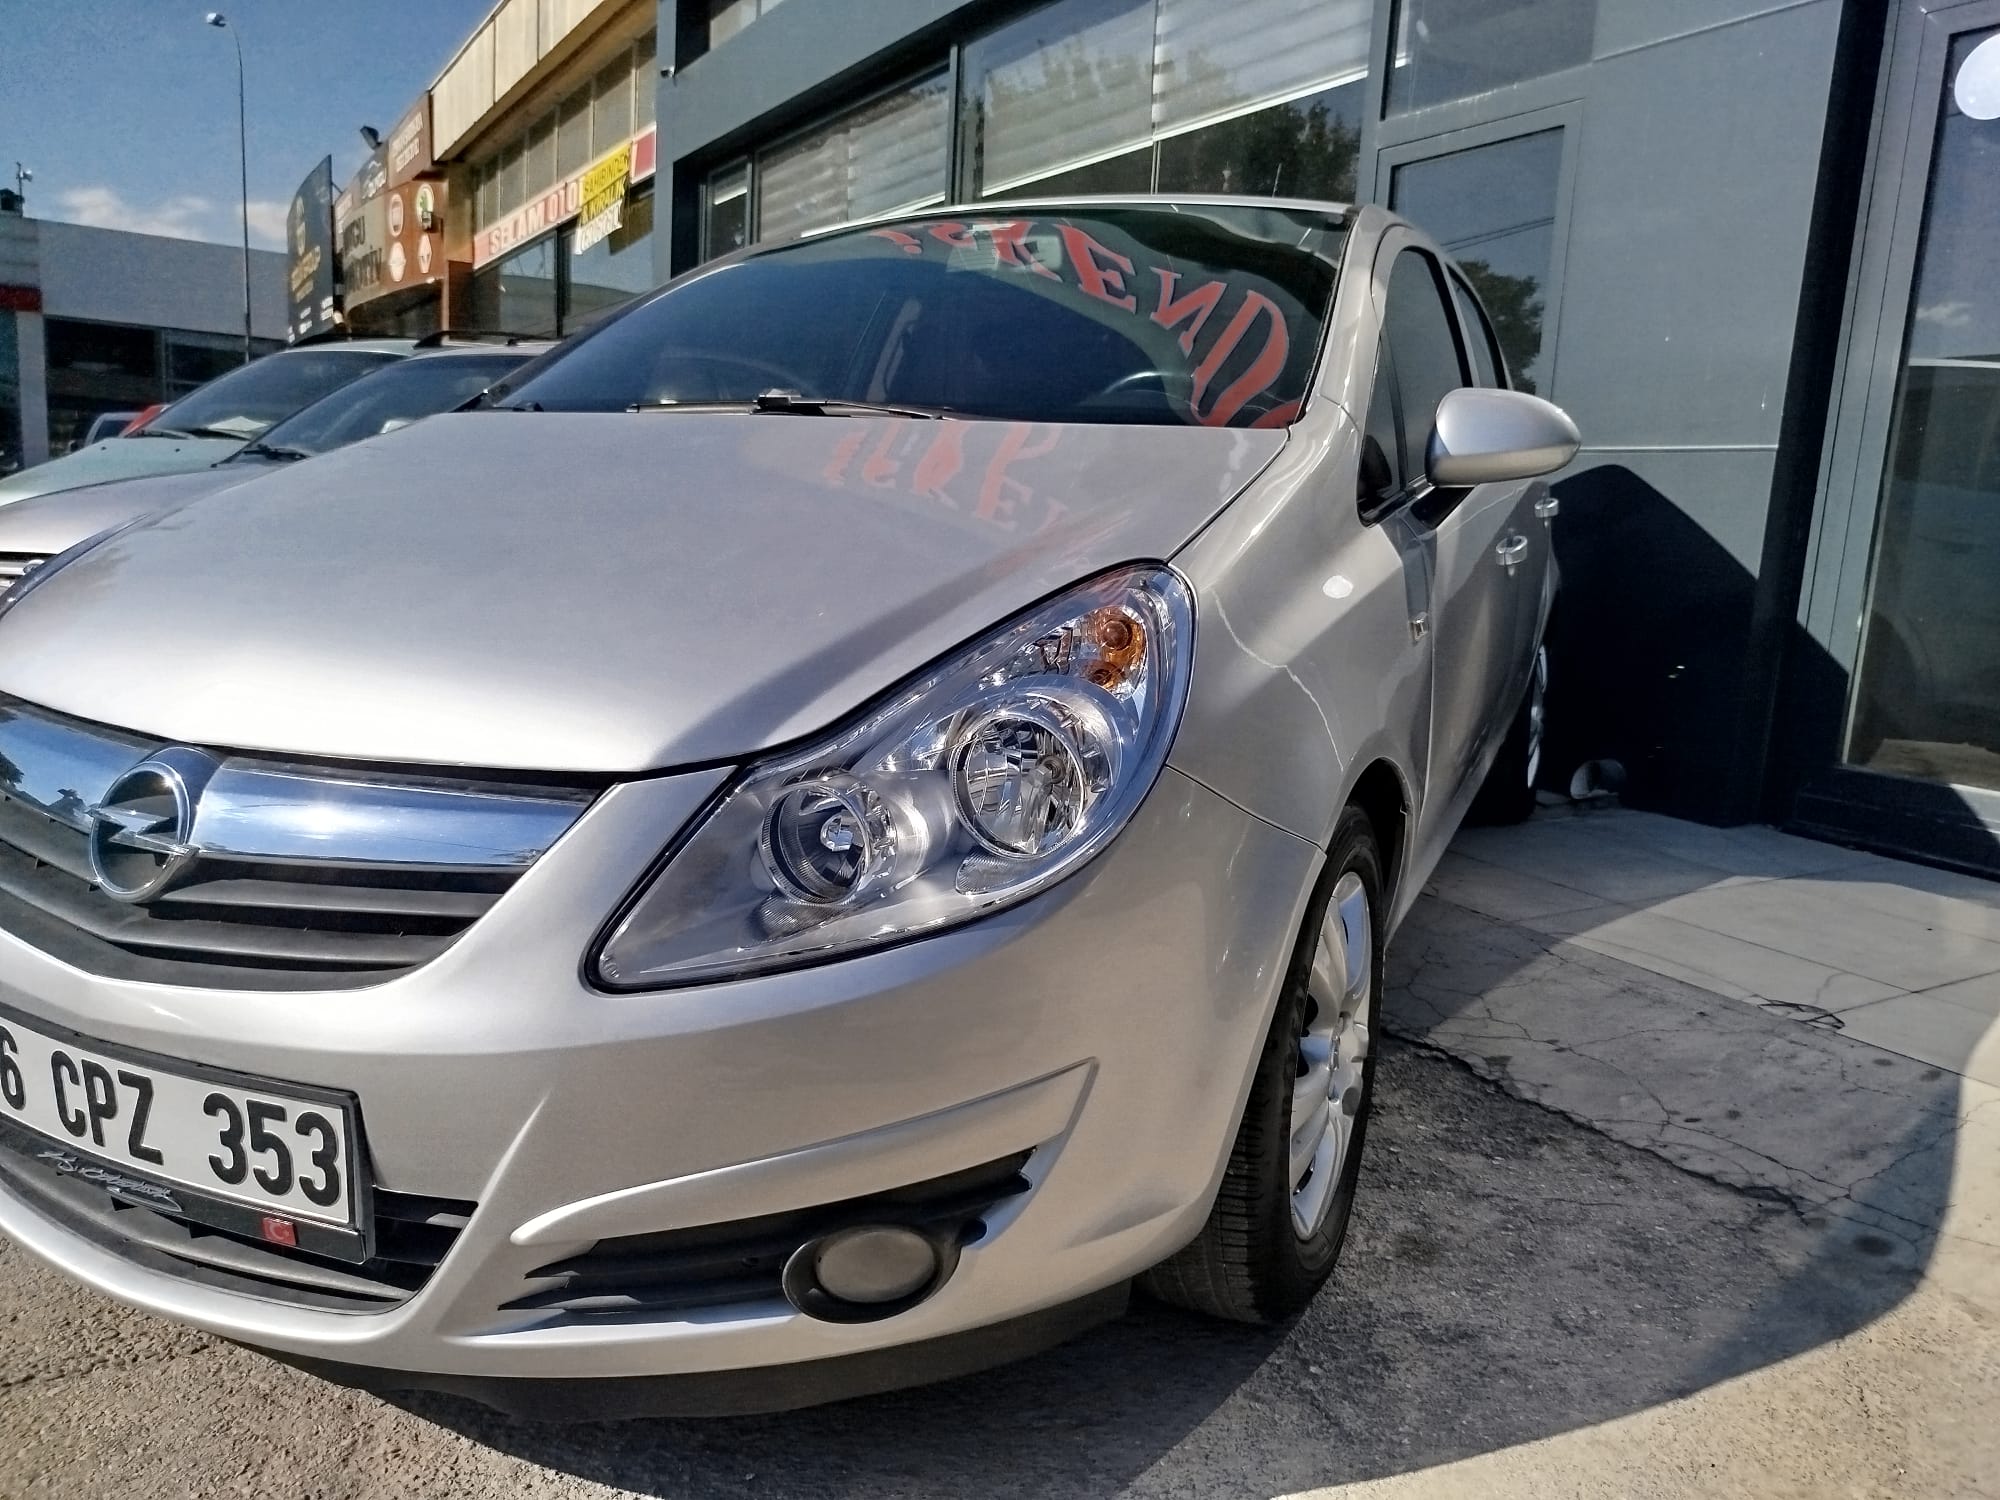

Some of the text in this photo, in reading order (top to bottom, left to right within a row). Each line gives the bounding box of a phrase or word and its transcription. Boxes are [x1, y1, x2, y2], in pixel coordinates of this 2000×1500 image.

[488, 200, 546, 255] SELAM
[546, 180, 579, 223] OTO
[50, 1049, 165, 1167] CPZ
[203, 1091, 343, 1208] 353
